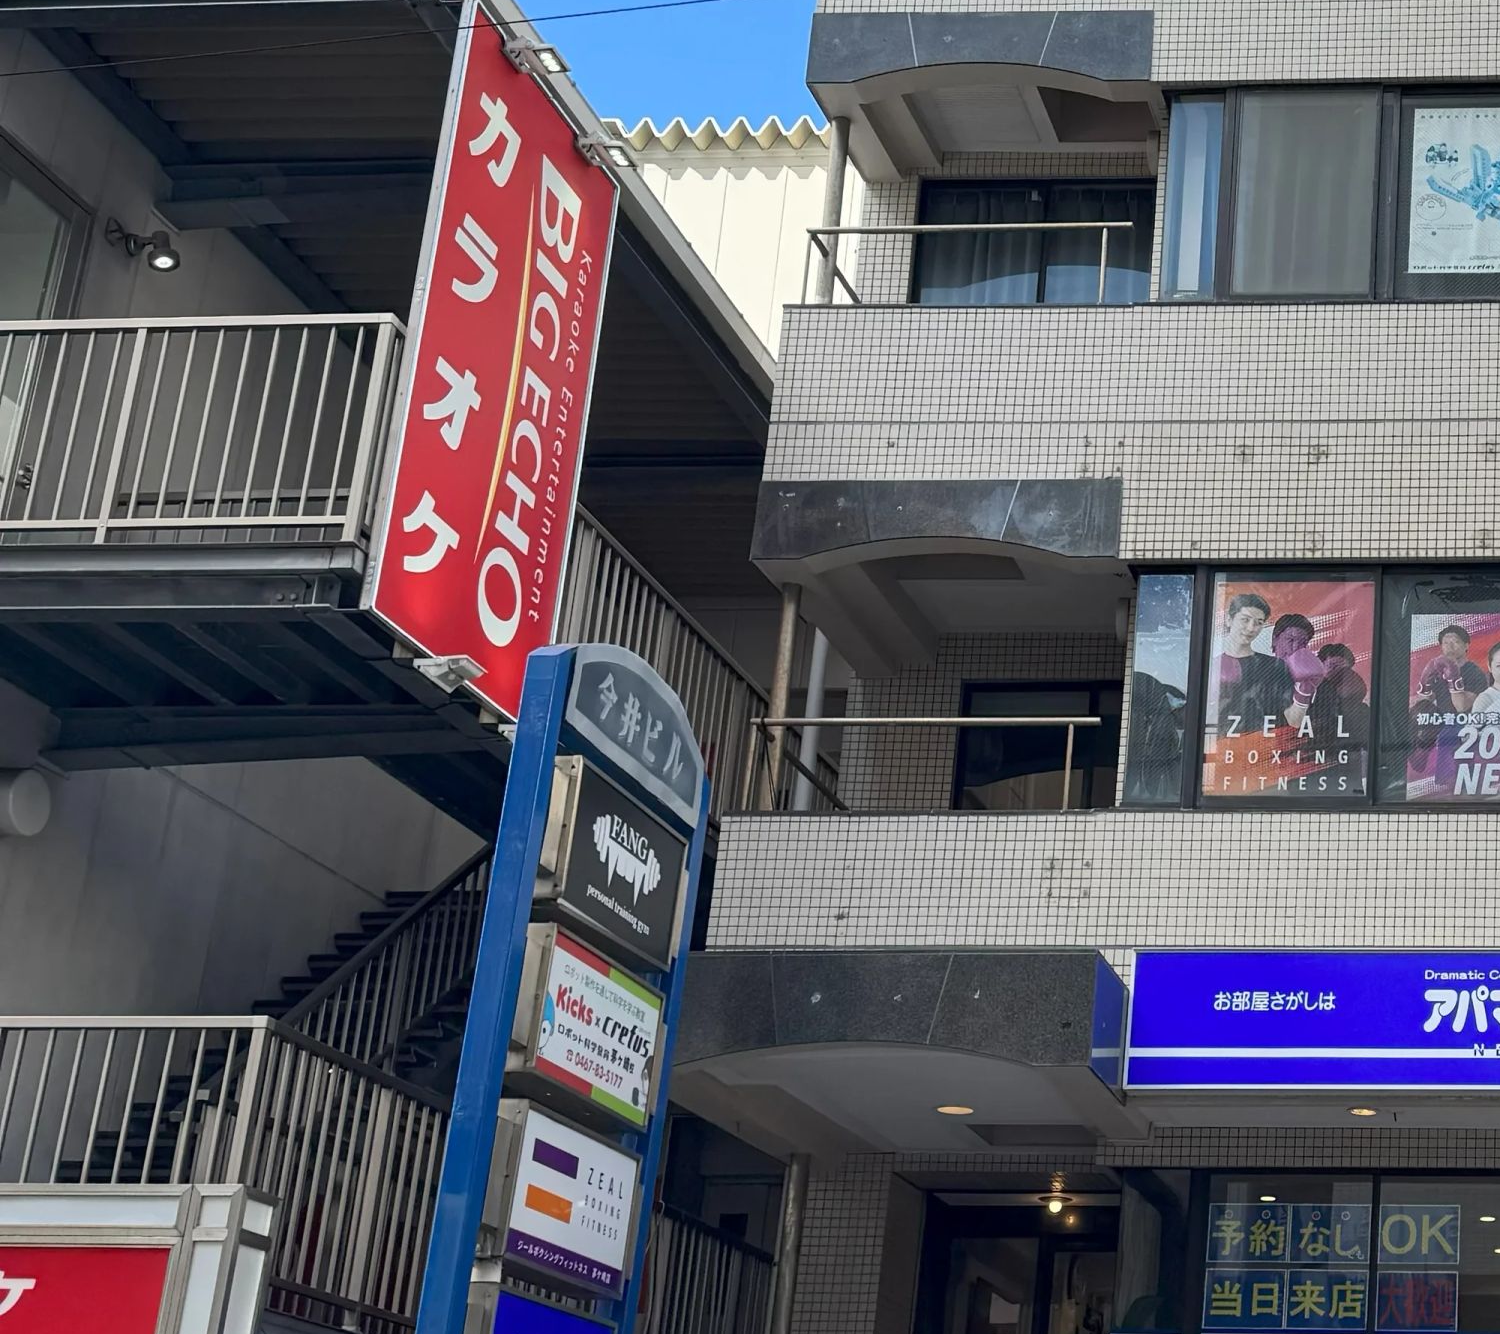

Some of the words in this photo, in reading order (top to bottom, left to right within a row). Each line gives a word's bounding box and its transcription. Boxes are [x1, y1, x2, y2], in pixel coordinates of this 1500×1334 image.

[529, 153, 582, 362] BIG
[564, 248, 593, 374] Karaoke
[402, 92, 523, 574] カラオケ
[477, 366, 552, 648] ECHO
[528, 386, 576, 624] Entertainment
[597, 672, 684, 781] 今井ビル
[1226, 715, 1350, 738] ZEAL
[1225, 750, 1348, 764] BOXING
[1223, 776, 1347, 791] FITNESS
[611, 814, 648, 860] FANG
[1424, 969, 1486, 981] Dramatic
[556, 983, 594, 1026] Kicks
[1213, 991, 1337, 1012] お部屋さがしは
[586, 1167, 624, 1200] ZEAL
[1381, 1214, 1457, 1255] OK
[1209, 1280, 1367, 1319] 当日来店
